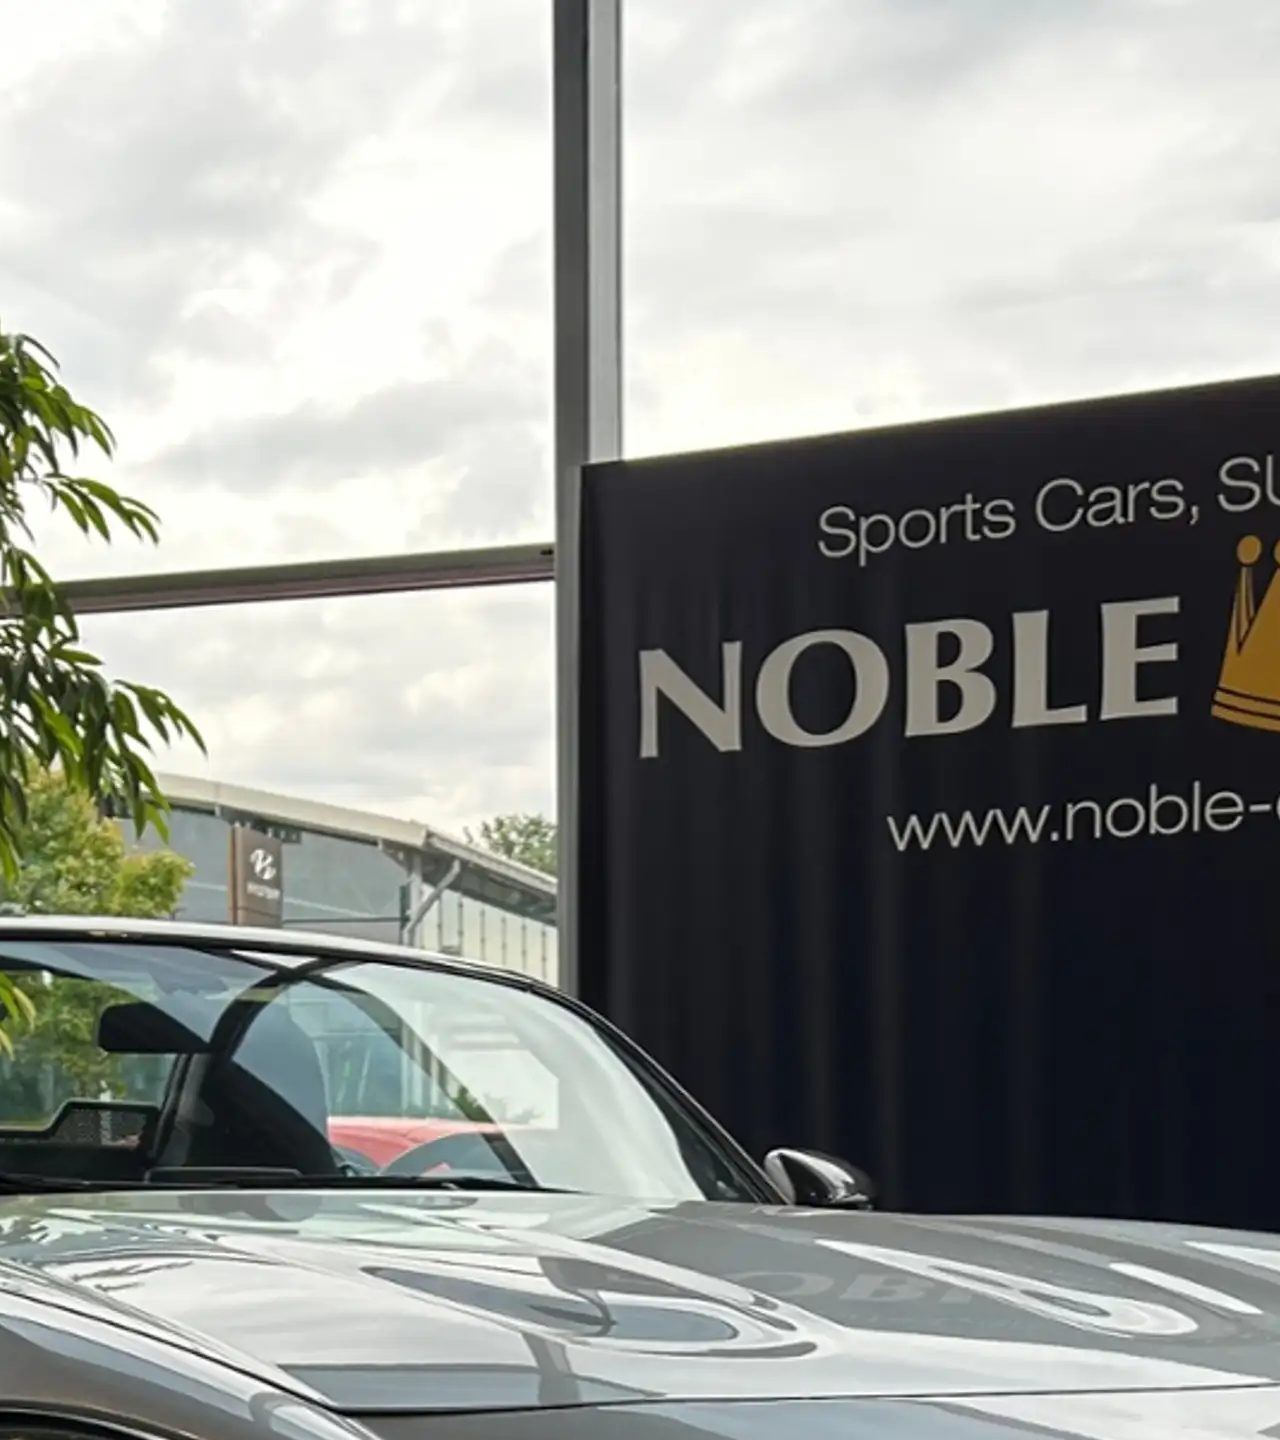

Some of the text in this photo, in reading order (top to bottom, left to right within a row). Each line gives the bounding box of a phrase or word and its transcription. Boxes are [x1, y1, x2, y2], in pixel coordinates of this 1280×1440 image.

[817, 493, 1016, 567] Sports
[1035, 477, 1200, 532] Cars,
[639, 596, 1180, 759] NOBLE
